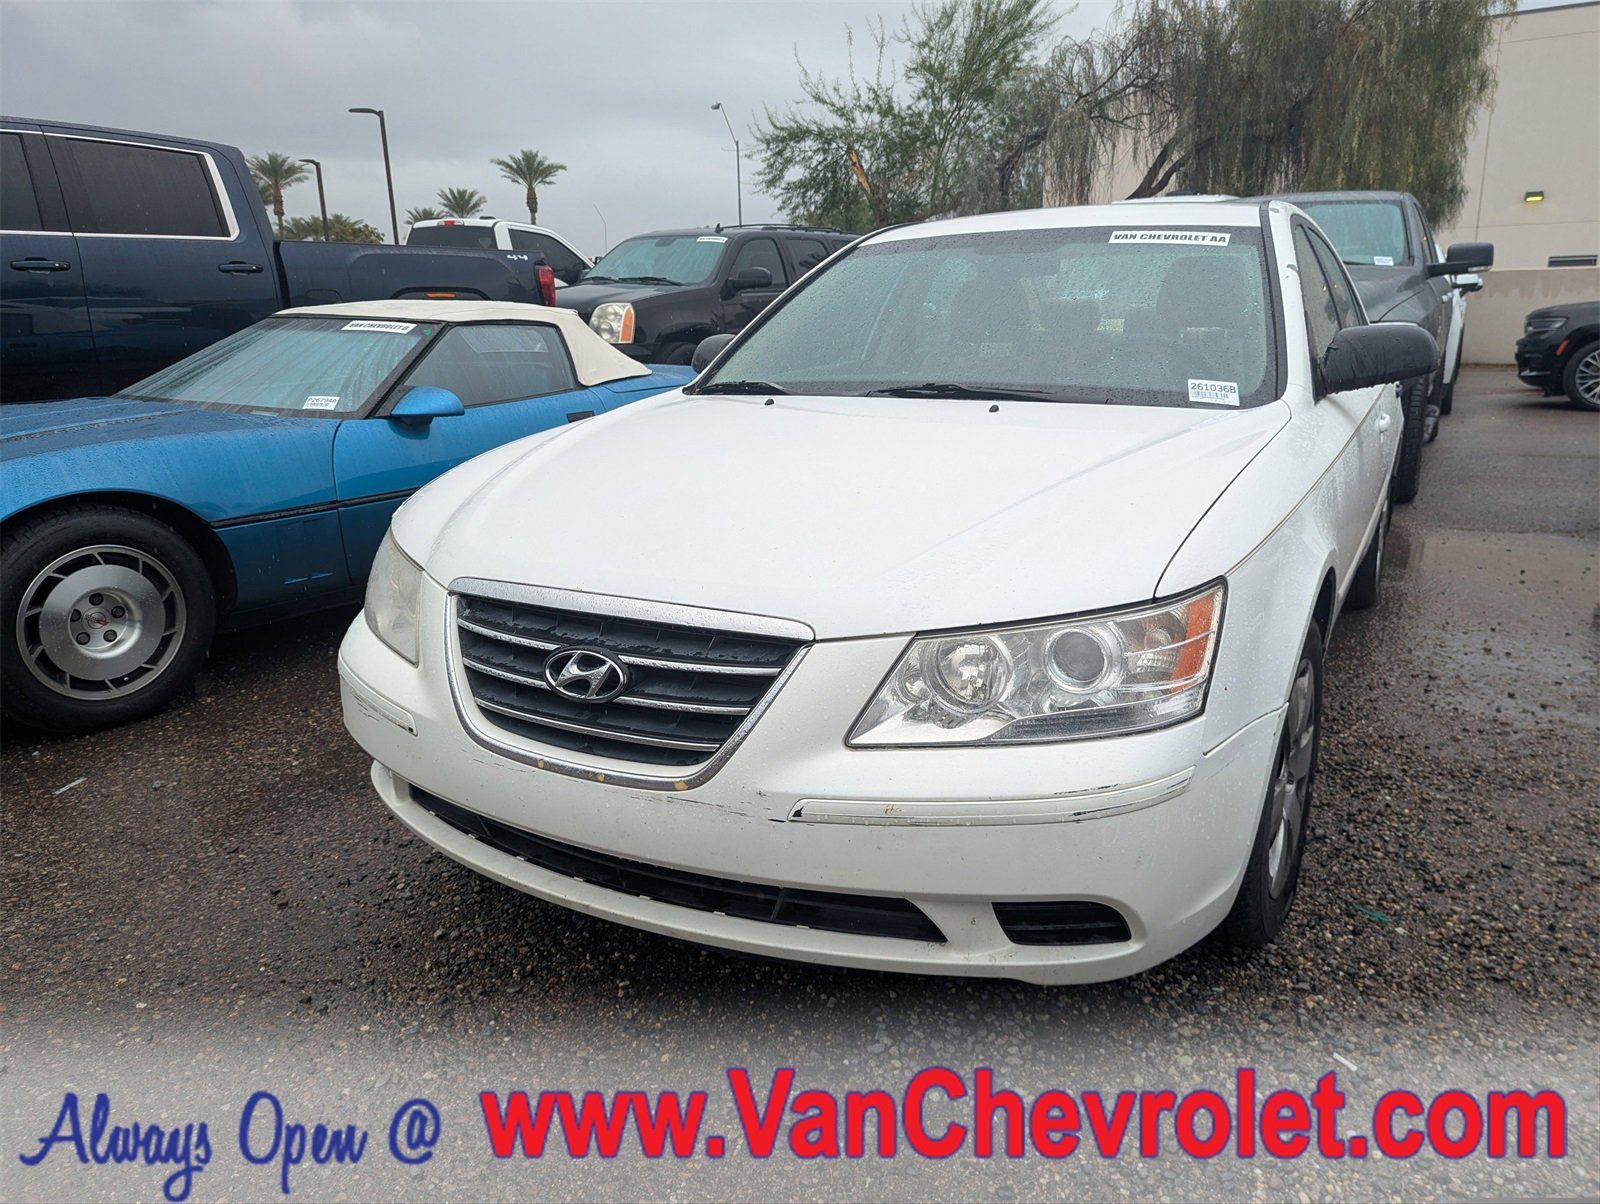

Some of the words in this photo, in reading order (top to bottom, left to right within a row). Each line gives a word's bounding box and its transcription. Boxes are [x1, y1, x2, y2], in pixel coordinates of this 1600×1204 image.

[1139, 233, 1208, 242] CHEVROLET
[1209, 235, 1227, 243] AA
[1190, 382, 1237, 394] 261036B
